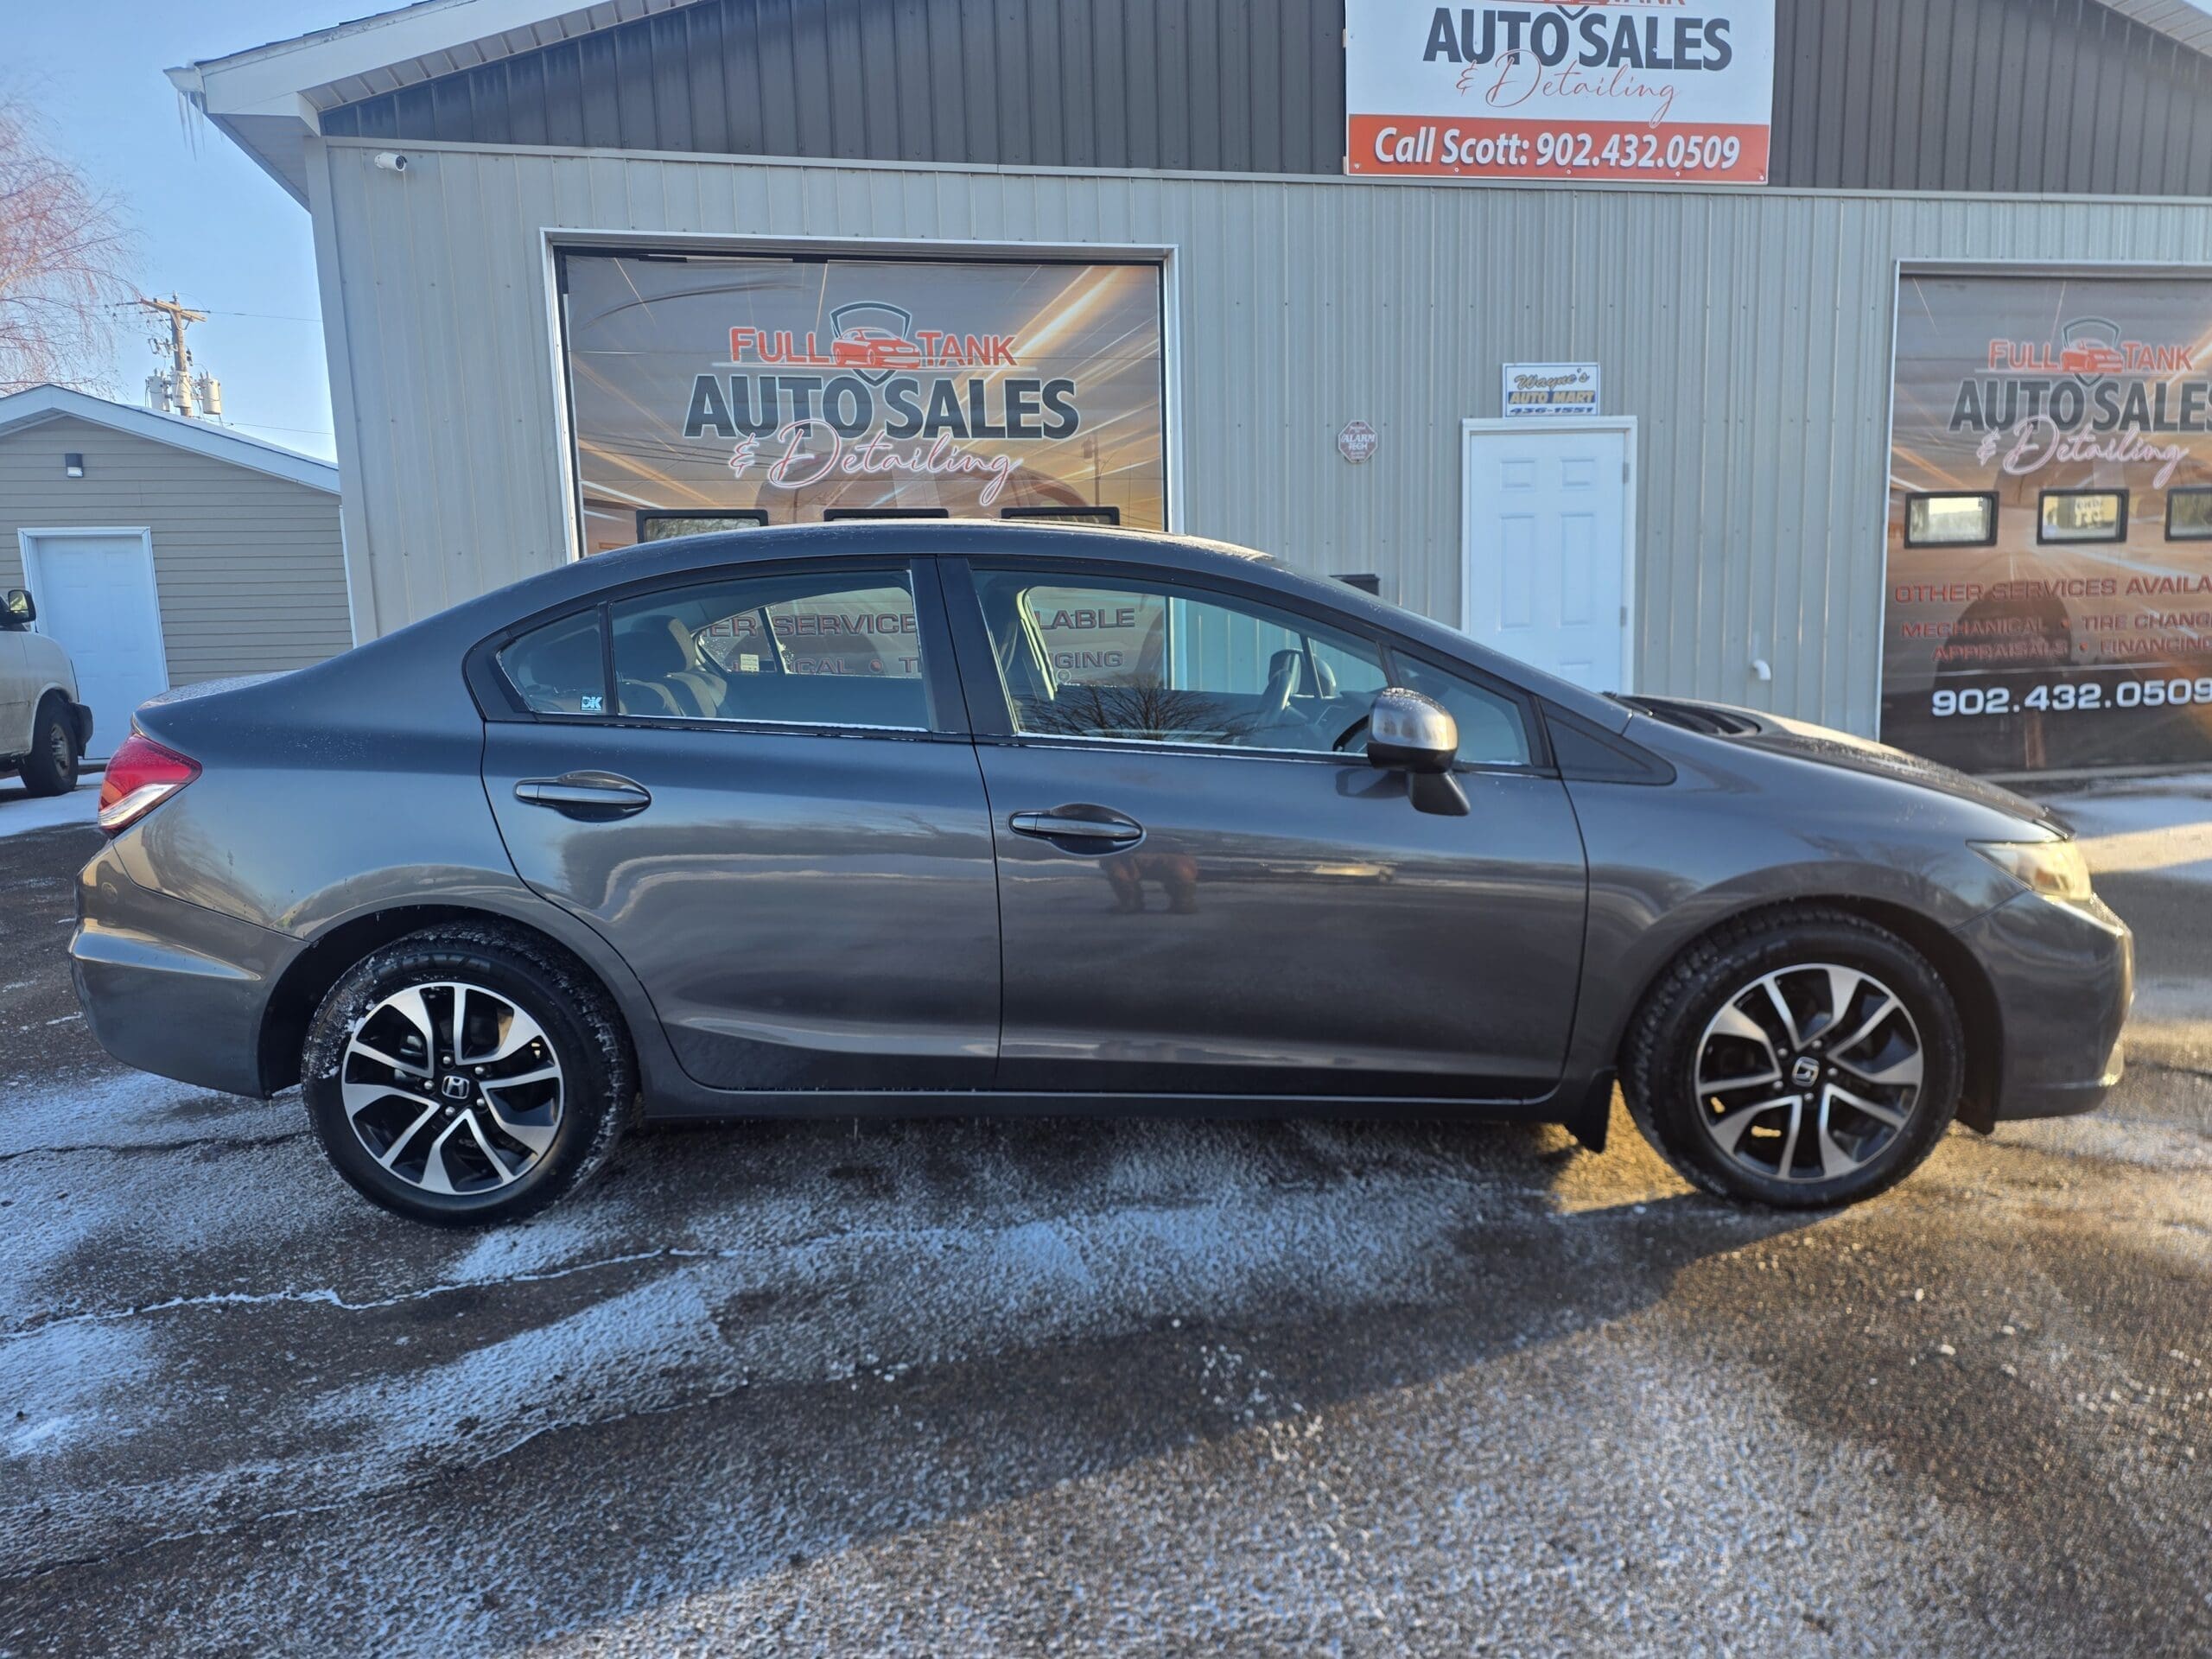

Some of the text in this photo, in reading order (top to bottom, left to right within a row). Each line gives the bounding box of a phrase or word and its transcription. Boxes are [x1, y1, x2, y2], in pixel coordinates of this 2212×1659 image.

[1423, 7, 1732, 72] AUTO SALES
[1456, 48, 1681, 129] & Detailing
[1375, 126, 1740, 170] Call Scott: 902.432.0509
[729, 326, 1019, 368] FULL TANK
[1988, 339, 2195, 372] FULL TANK
[1510, 391, 1595, 404] AUTO MART
[1514, 367, 1591, 391] Wayne's
[683, 373, 1080, 442] AUTO SALES
[1948, 378, 2212, 433] AUTO SALE
[728, 418, 1025, 507] & Detailing
[1976, 415, 2190, 490] & Detailing
[1895, 582, 1984, 604] OTHER
[1991, 578, 2117, 602] SERVICES
[1901, 610, 2212, 639] MECHANICAL TIRE CHANG
[1047, 650, 1123, 670] GING
[1932, 640, 2069, 662] APPRAISALS
[1932, 678, 2212, 717] 902.432.0509
